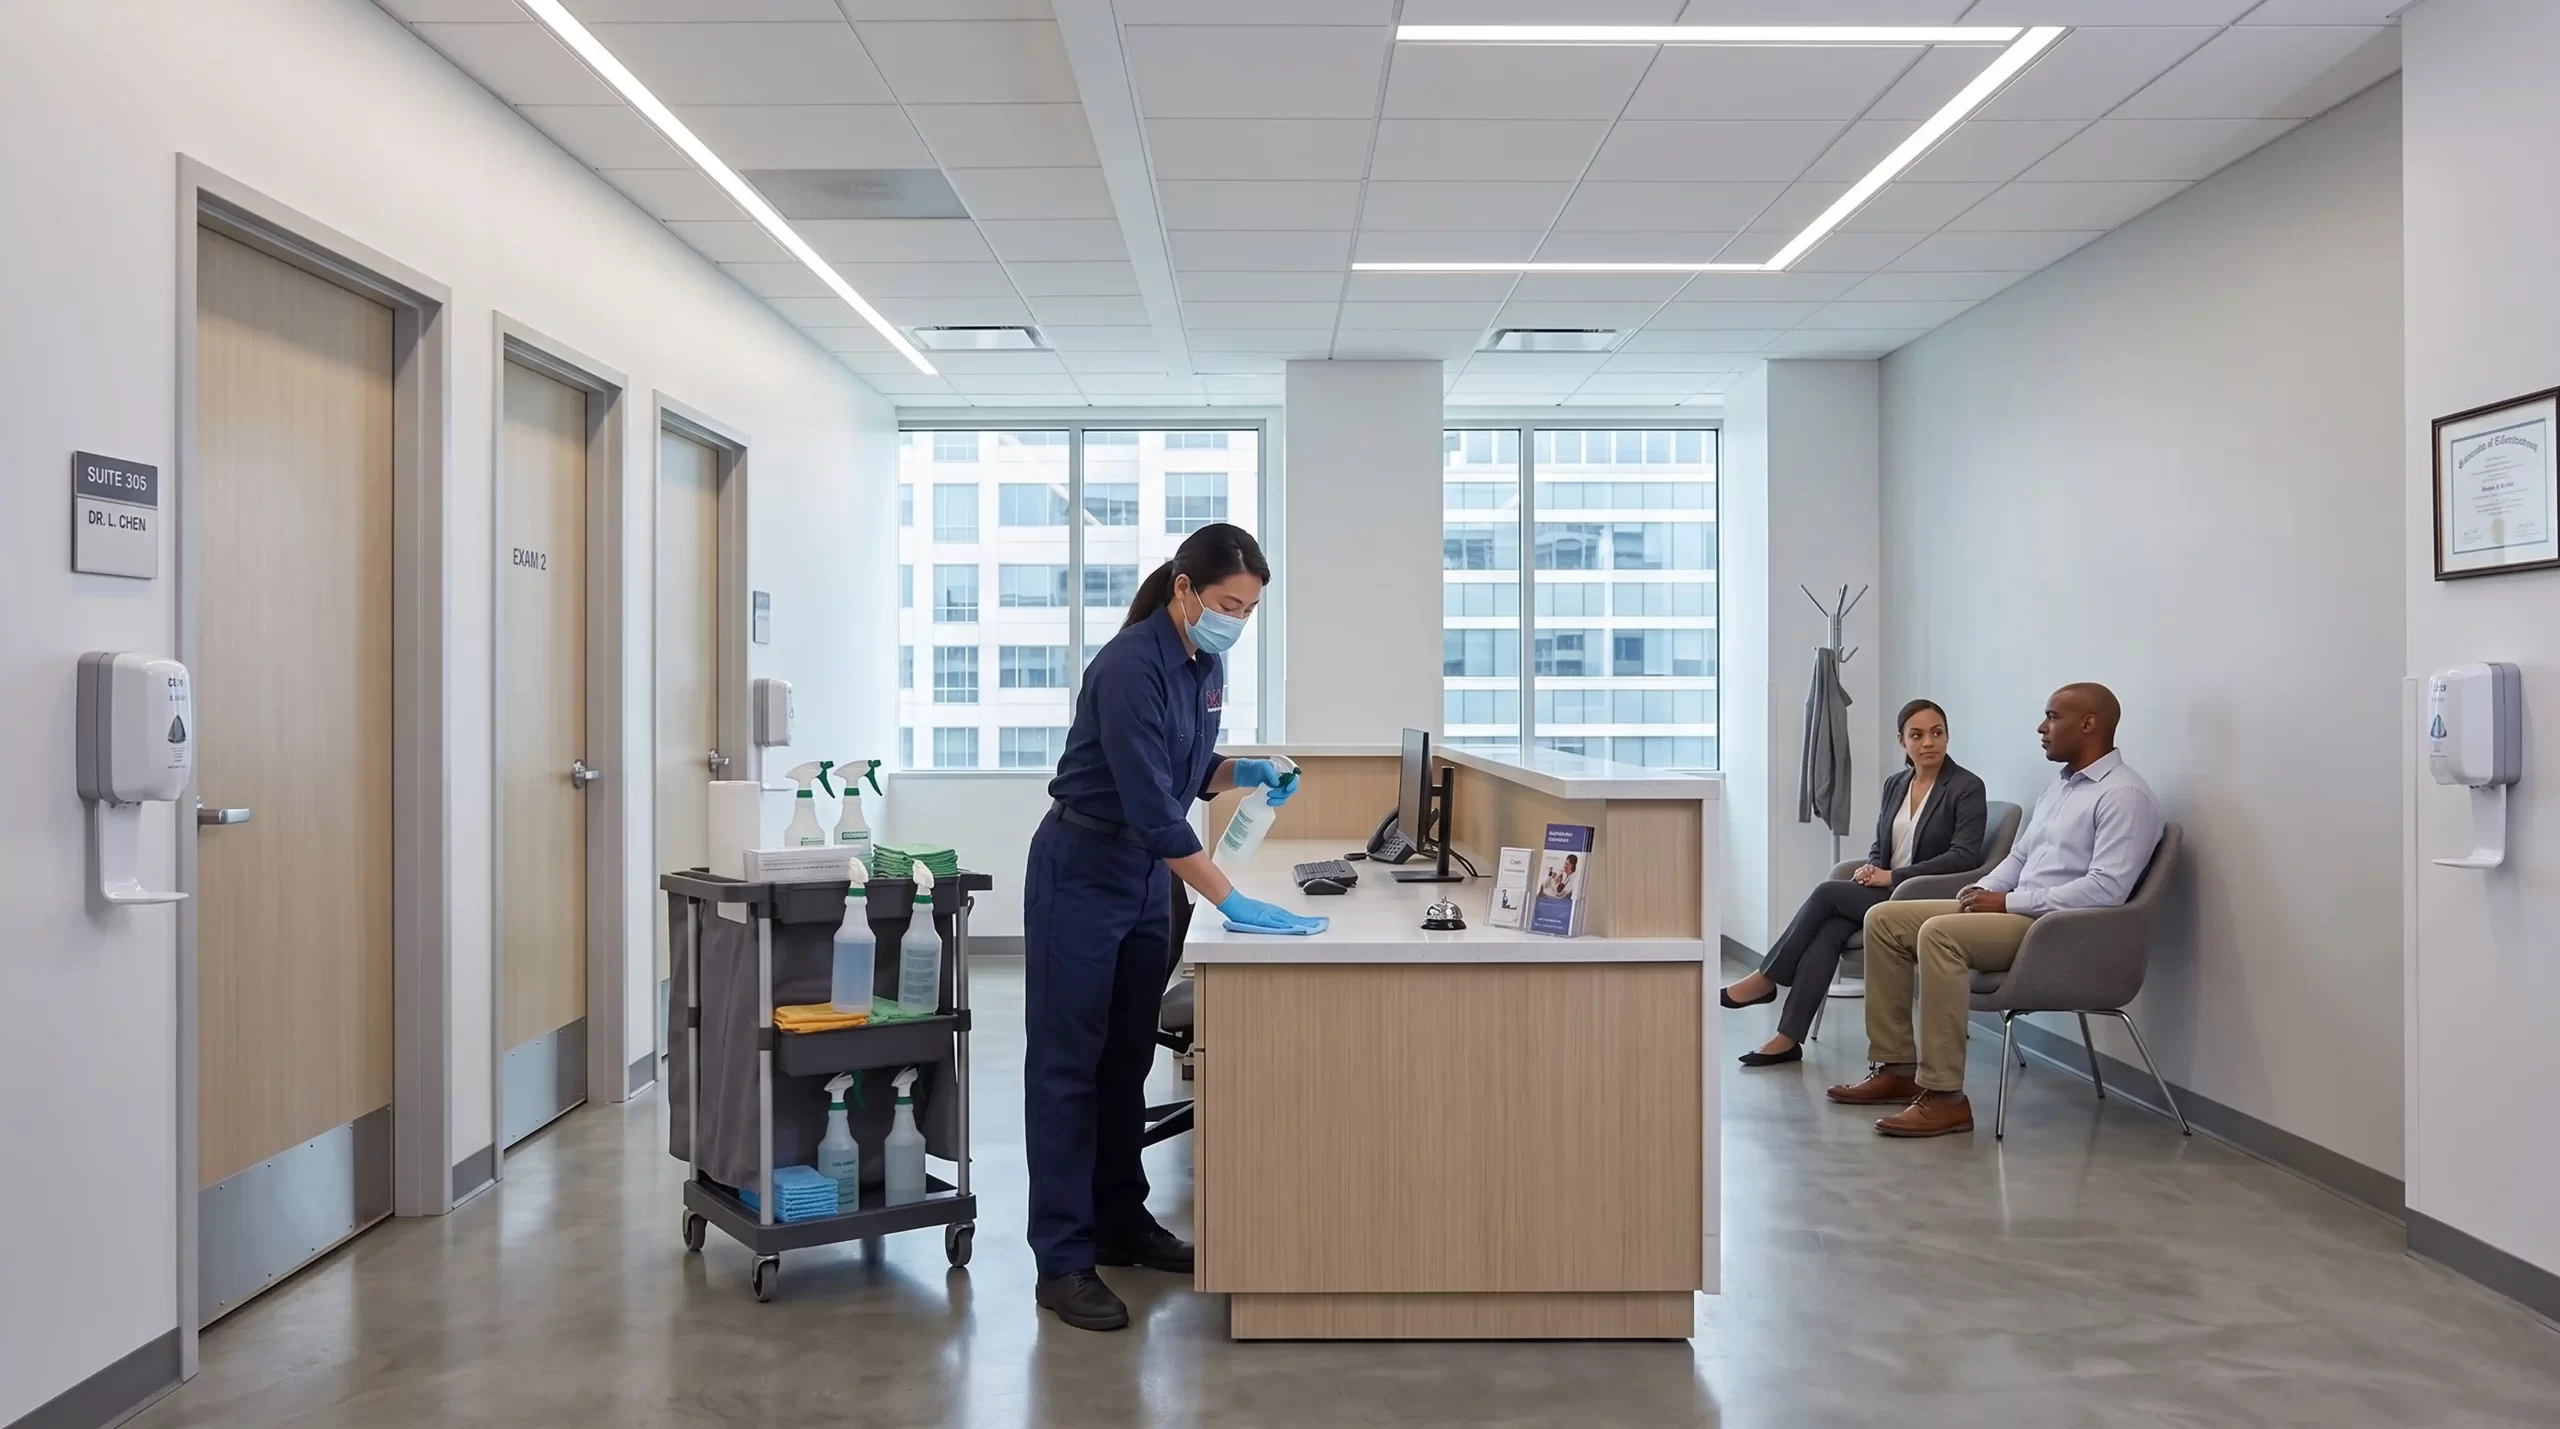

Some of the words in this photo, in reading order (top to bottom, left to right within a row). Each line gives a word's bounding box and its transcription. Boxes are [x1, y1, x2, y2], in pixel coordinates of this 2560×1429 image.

[87, 466, 122, 487] SUITE
[125, 473, 147, 491] 305
[88, 510, 106, 526] DR.
[108, 513, 117, 527] L.
[119, 515, 146, 532] CHEN
[513, 548, 539, 570] EXAM
[541, 553, 547, 571] 2
